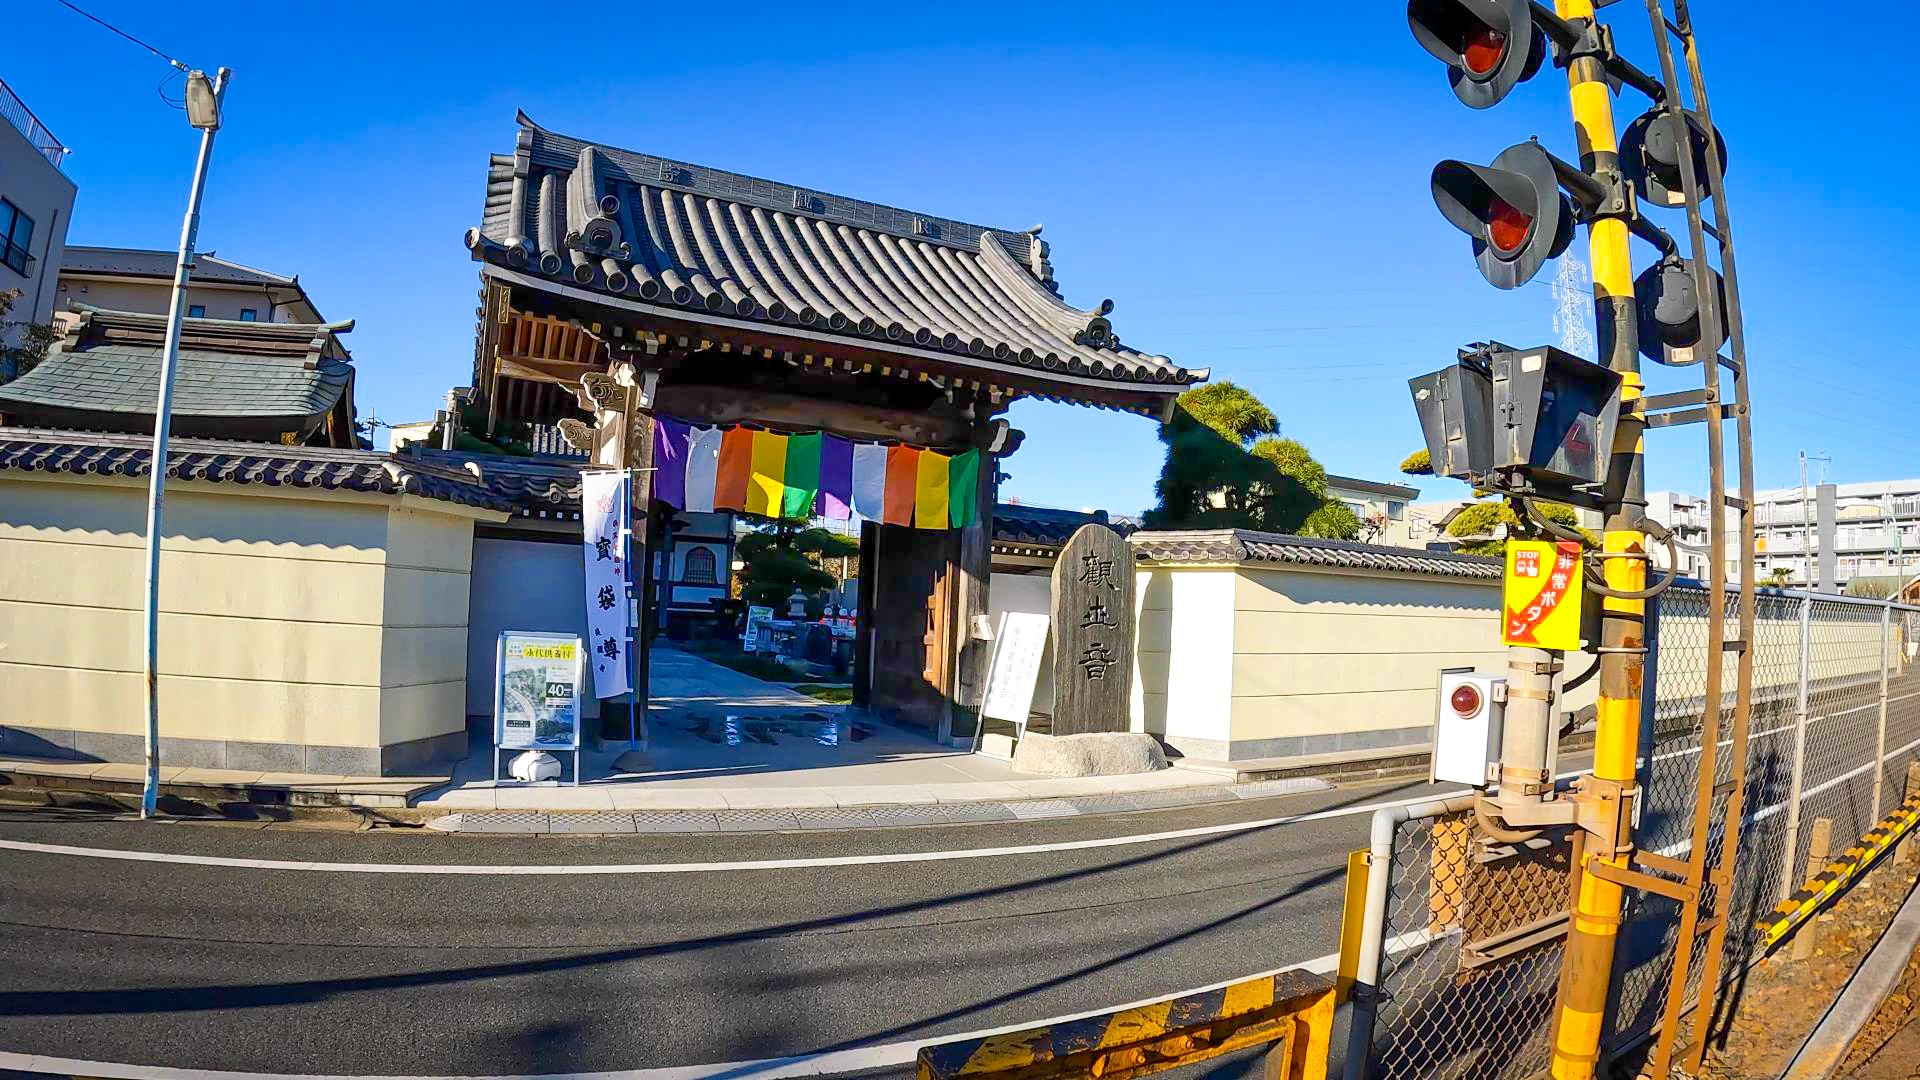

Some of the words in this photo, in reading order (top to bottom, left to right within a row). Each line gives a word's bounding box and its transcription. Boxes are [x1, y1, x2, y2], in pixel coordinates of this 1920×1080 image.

[1517, 551, 1539, 559] STOP
[1511, 554, 1574, 636] 非常ボタン
[548, 684, 564, 697] 40
